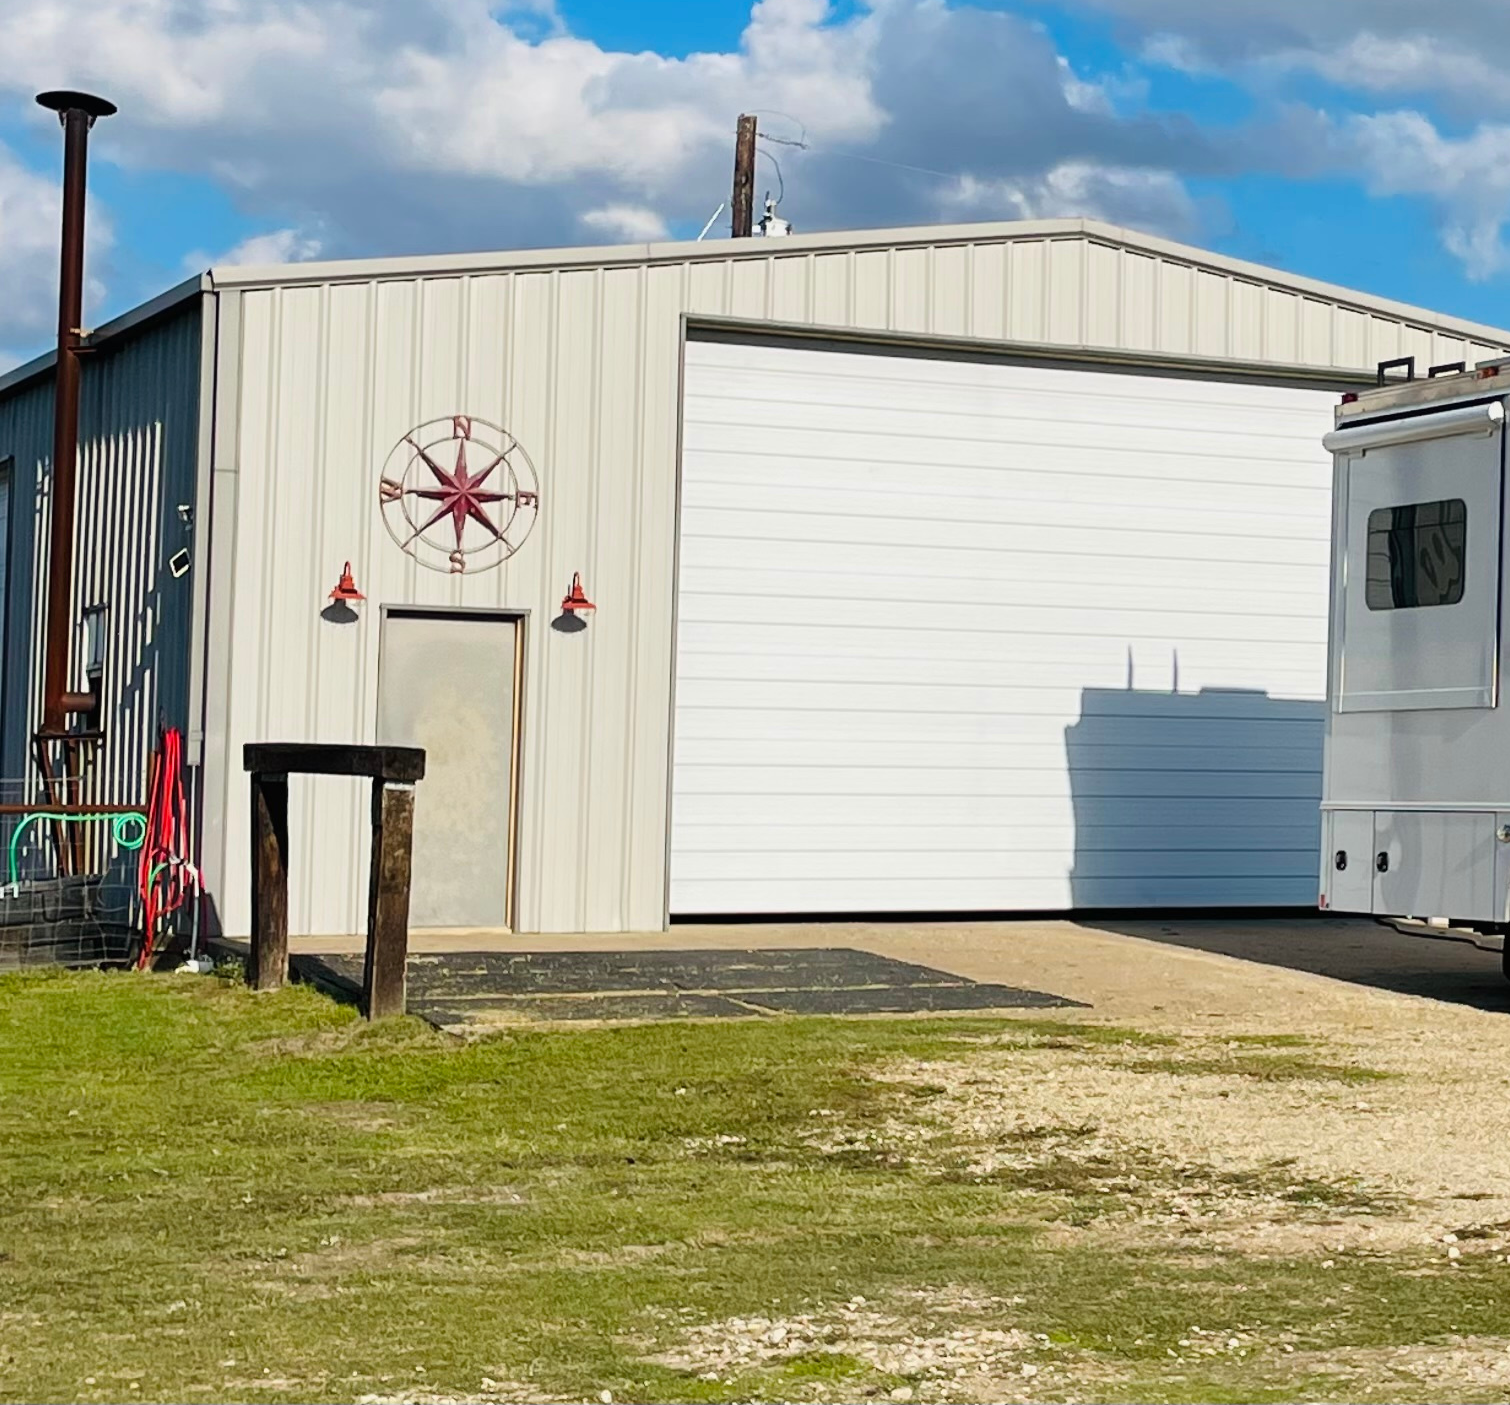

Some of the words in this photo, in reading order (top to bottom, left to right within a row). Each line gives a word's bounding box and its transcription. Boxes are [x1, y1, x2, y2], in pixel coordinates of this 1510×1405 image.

[453, 415, 471, 441] N
[380, 476, 402, 504] W
[516, 491, 538, 509] E
[449, 549, 466, 574] S
